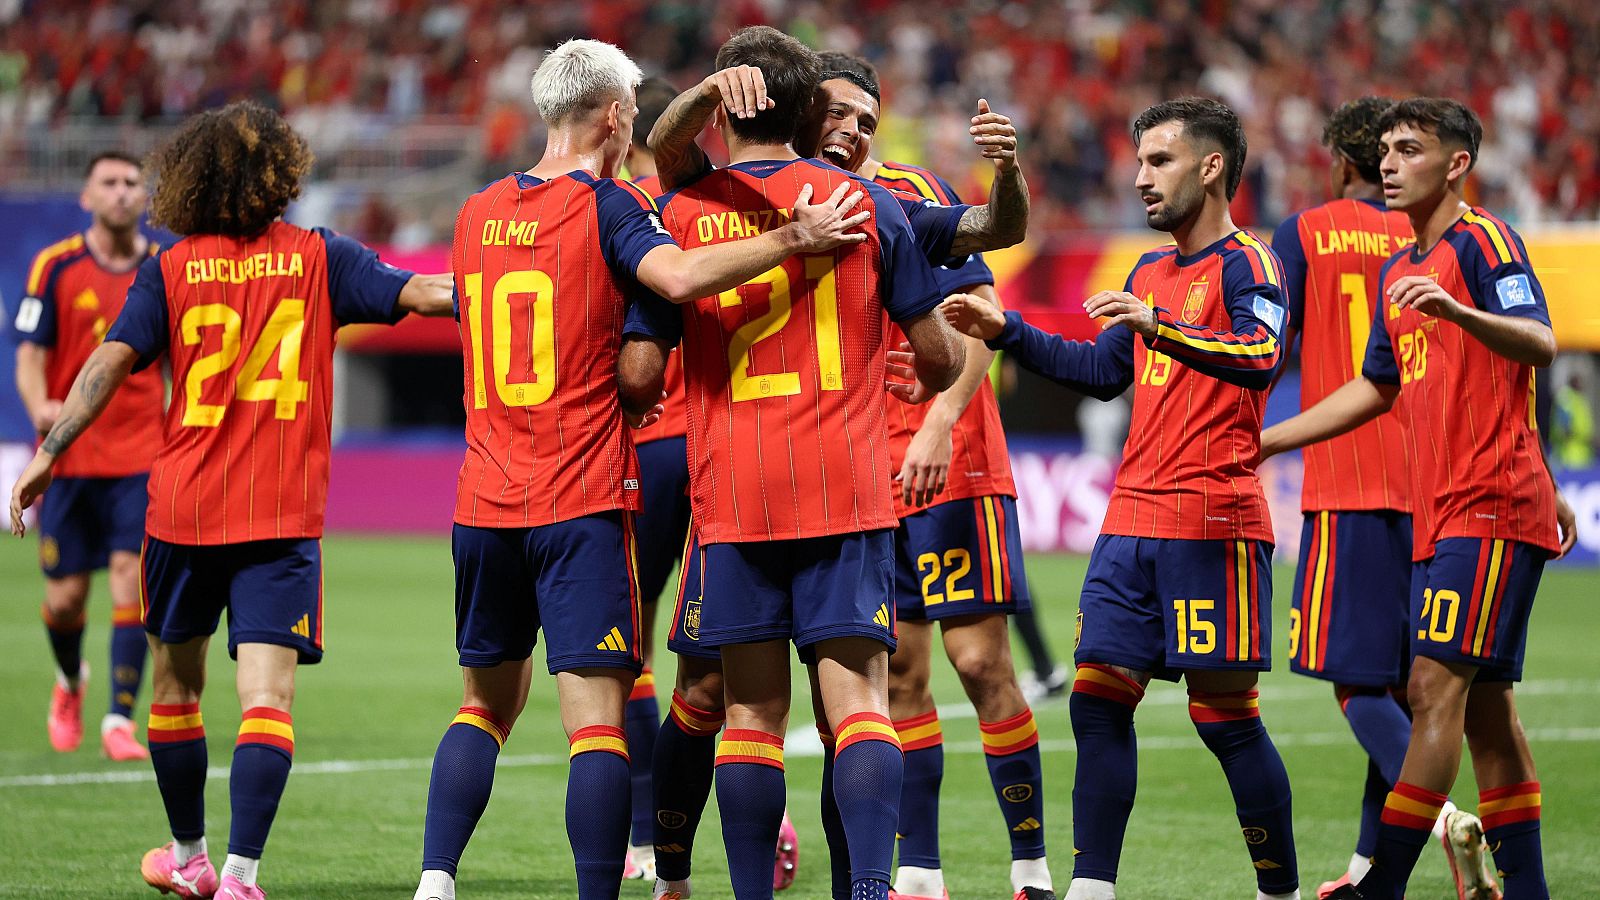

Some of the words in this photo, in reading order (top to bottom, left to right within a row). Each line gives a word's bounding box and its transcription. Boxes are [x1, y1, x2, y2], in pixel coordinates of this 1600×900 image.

[482, 219, 540, 246] OLMO
[697, 208, 794, 243] OYARZA
[1315, 230, 1392, 258] LAMINE
[186, 252, 304, 285] CUCURELLA
[464, 269, 556, 410] 10
[719, 256, 843, 403] 21
[1398, 328, 1429, 385] 20
[182, 298, 308, 427] 24
[1140, 348, 1172, 387] 15
[917, 548, 975, 606] 22
[1173, 599, 1216, 654] 15
[1417, 587, 1461, 643] 20
